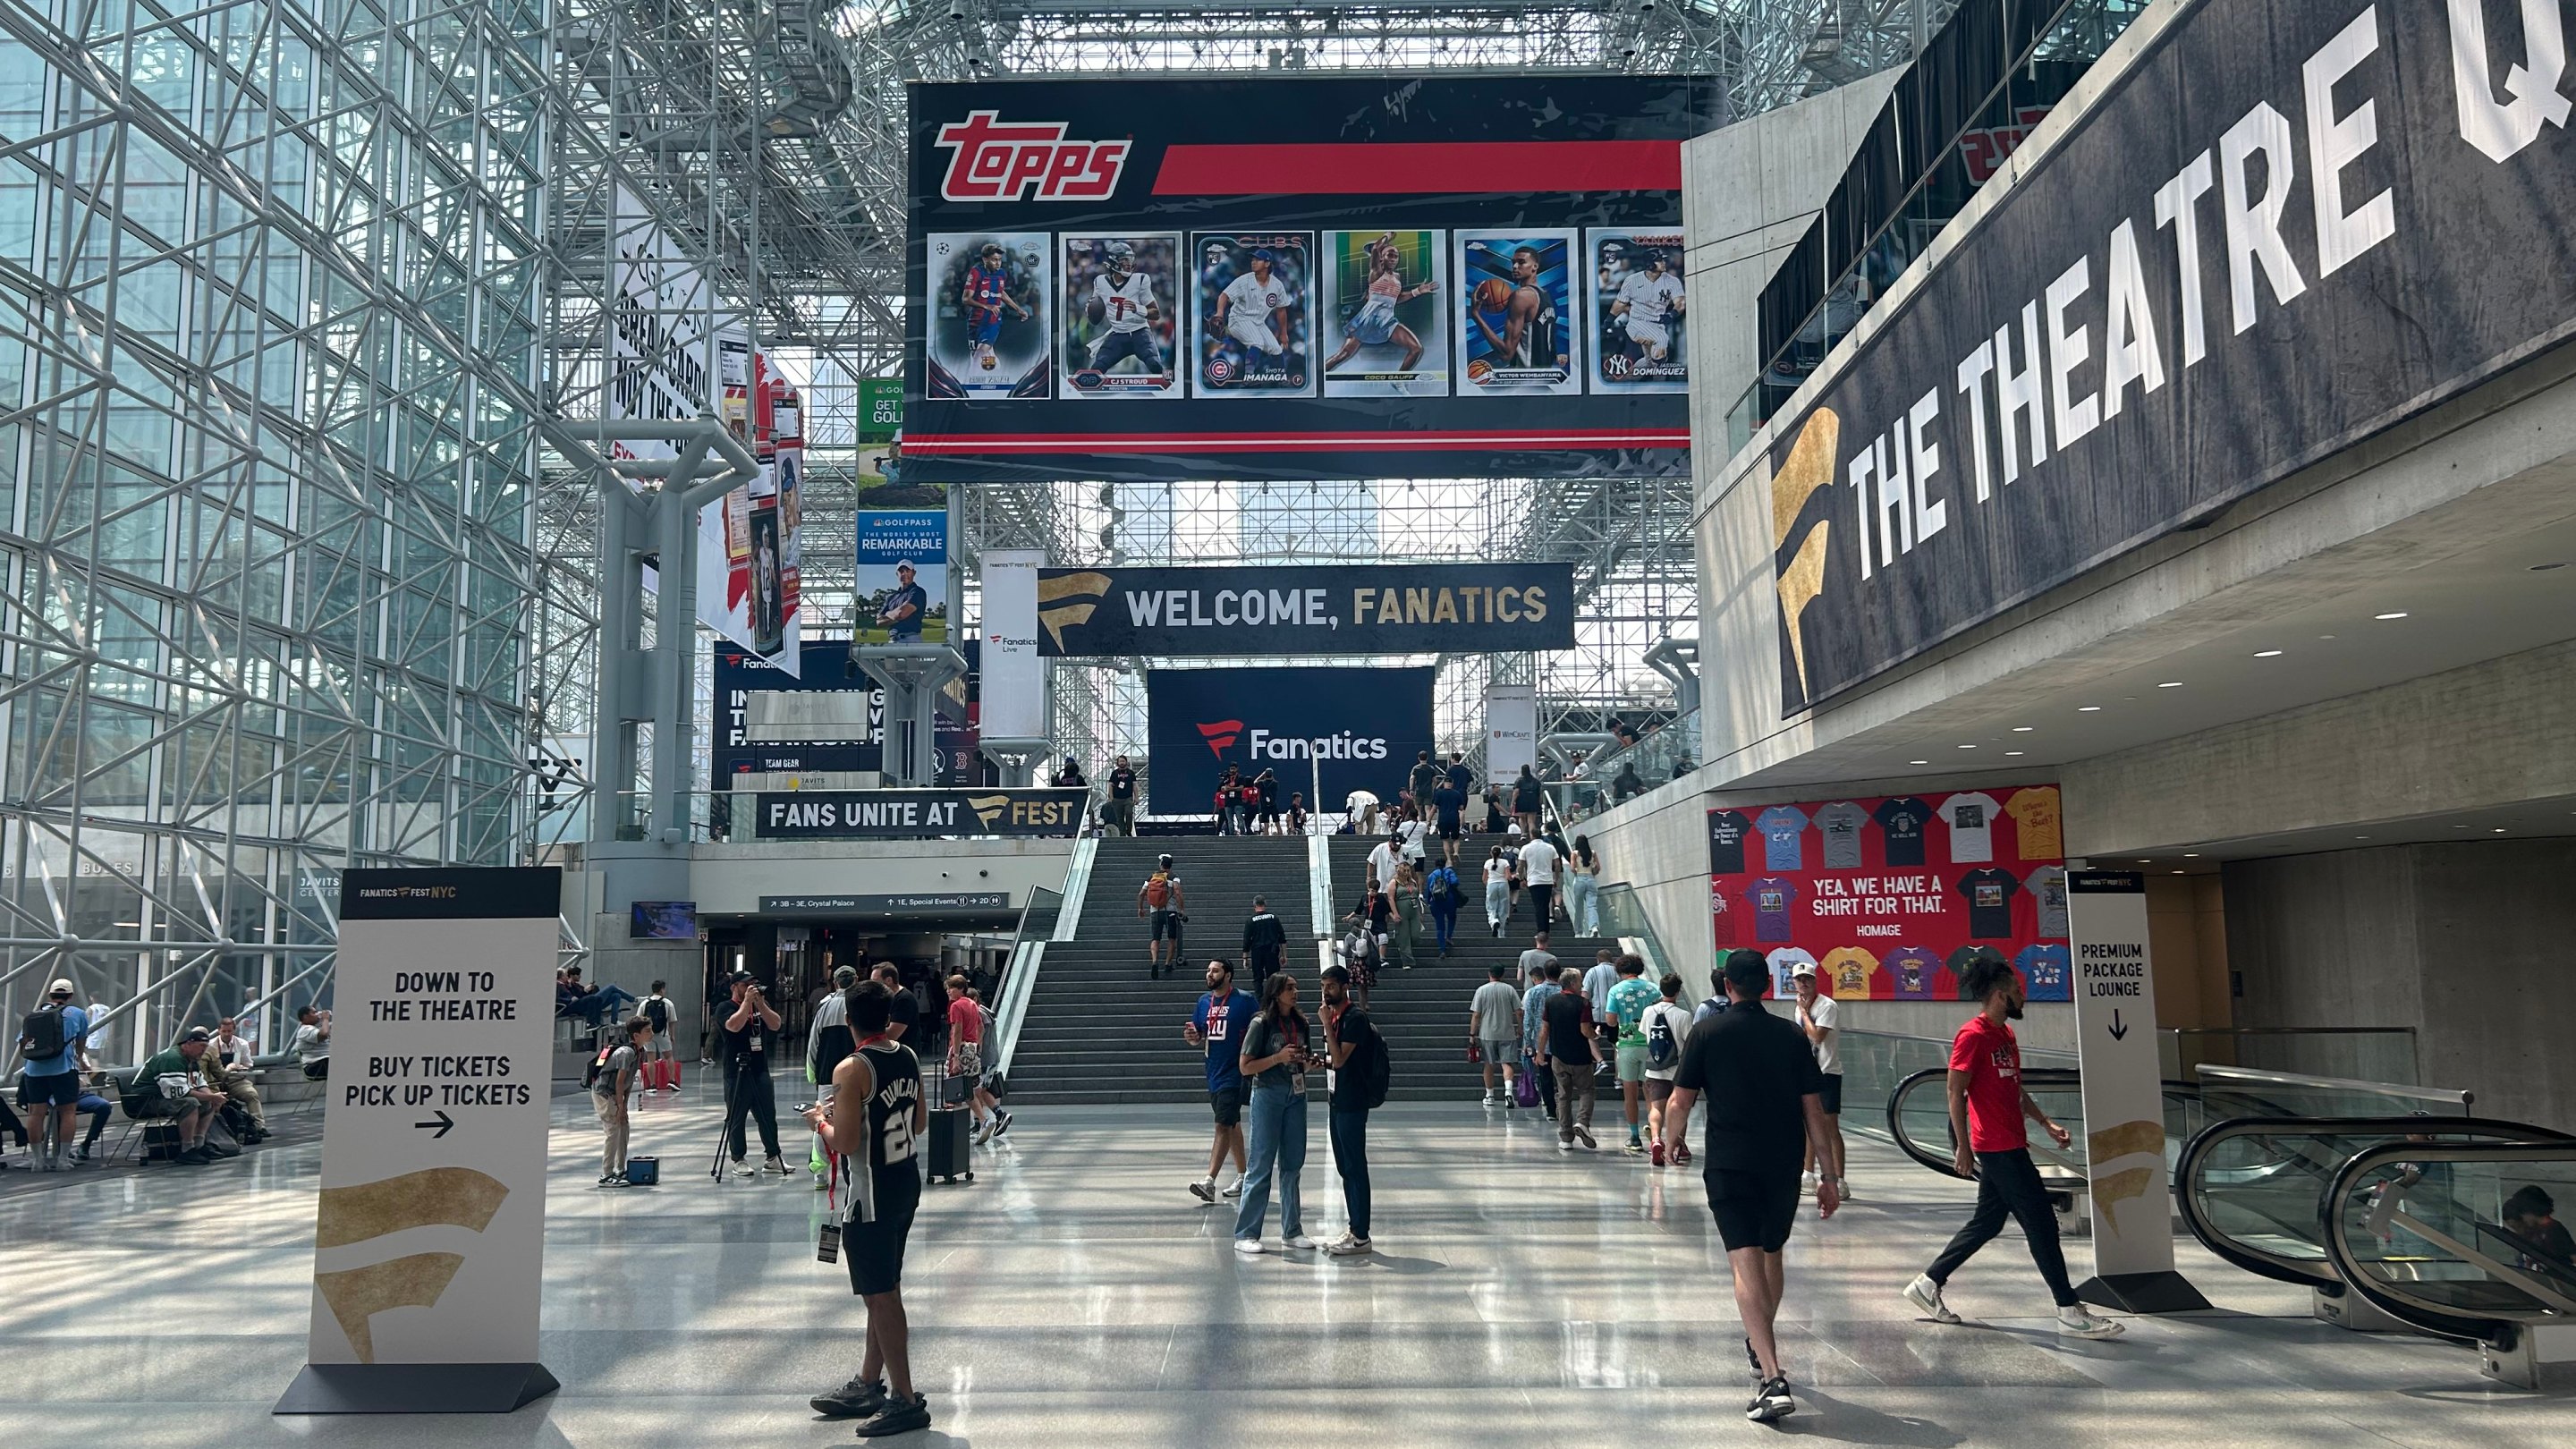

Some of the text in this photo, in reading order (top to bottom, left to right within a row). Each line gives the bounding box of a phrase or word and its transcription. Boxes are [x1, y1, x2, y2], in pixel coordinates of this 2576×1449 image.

[1238, 236, 1302, 248] CUBS
[1848, 386, 1947, 581] THE
[1957, 4, 2395, 504] THEATRE
[670, 340, 707, 411] CARDS
[876, 400, 898, 410] GET
[885, 519, 932, 527] GOLFPASS
[862, 538, 943, 550] REMARKABLE
[1125, 585, 1547, 631] WELCOME, FANATICS
[1250, 727, 1387, 761] Fanatics
[765, 758, 800, 768] TEAM GEAR
[770, 801, 1073, 827] FANS UNITE AT FEST
[82, 862, 133, 874] BUES
[300, 877, 340, 887] JAVITS
[1812, 875, 1943, 897] YEA, WE HAVE A
[360, 886, 456, 898] FANATICS FEST NYC
[808, 900, 830, 908] Crystal
[909, 898, 933, 906] Special
[1812, 895, 1946, 916] SHIRT FOR THAT.
[1252, 913, 1275, 922] SECURITY
[1857, 925, 1902, 936] HOMAGE
[2080, 944, 2142, 958] PREMIUM
[2083, 962, 2143, 978] PACKAGE
[395, 971, 495, 993] DOWN TO
[2089, 982, 2140, 996] LOUNGE
[370, 999, 516, 1021] THE THEATRE
[369, 1055, 511, 1077] BUY TICKETS
[345, 1084, 530, 1106] PICK UP TICKETS
[879, 1077, 920, 1108] DUNCAN
[883, 1104, 917, 1165] 21
